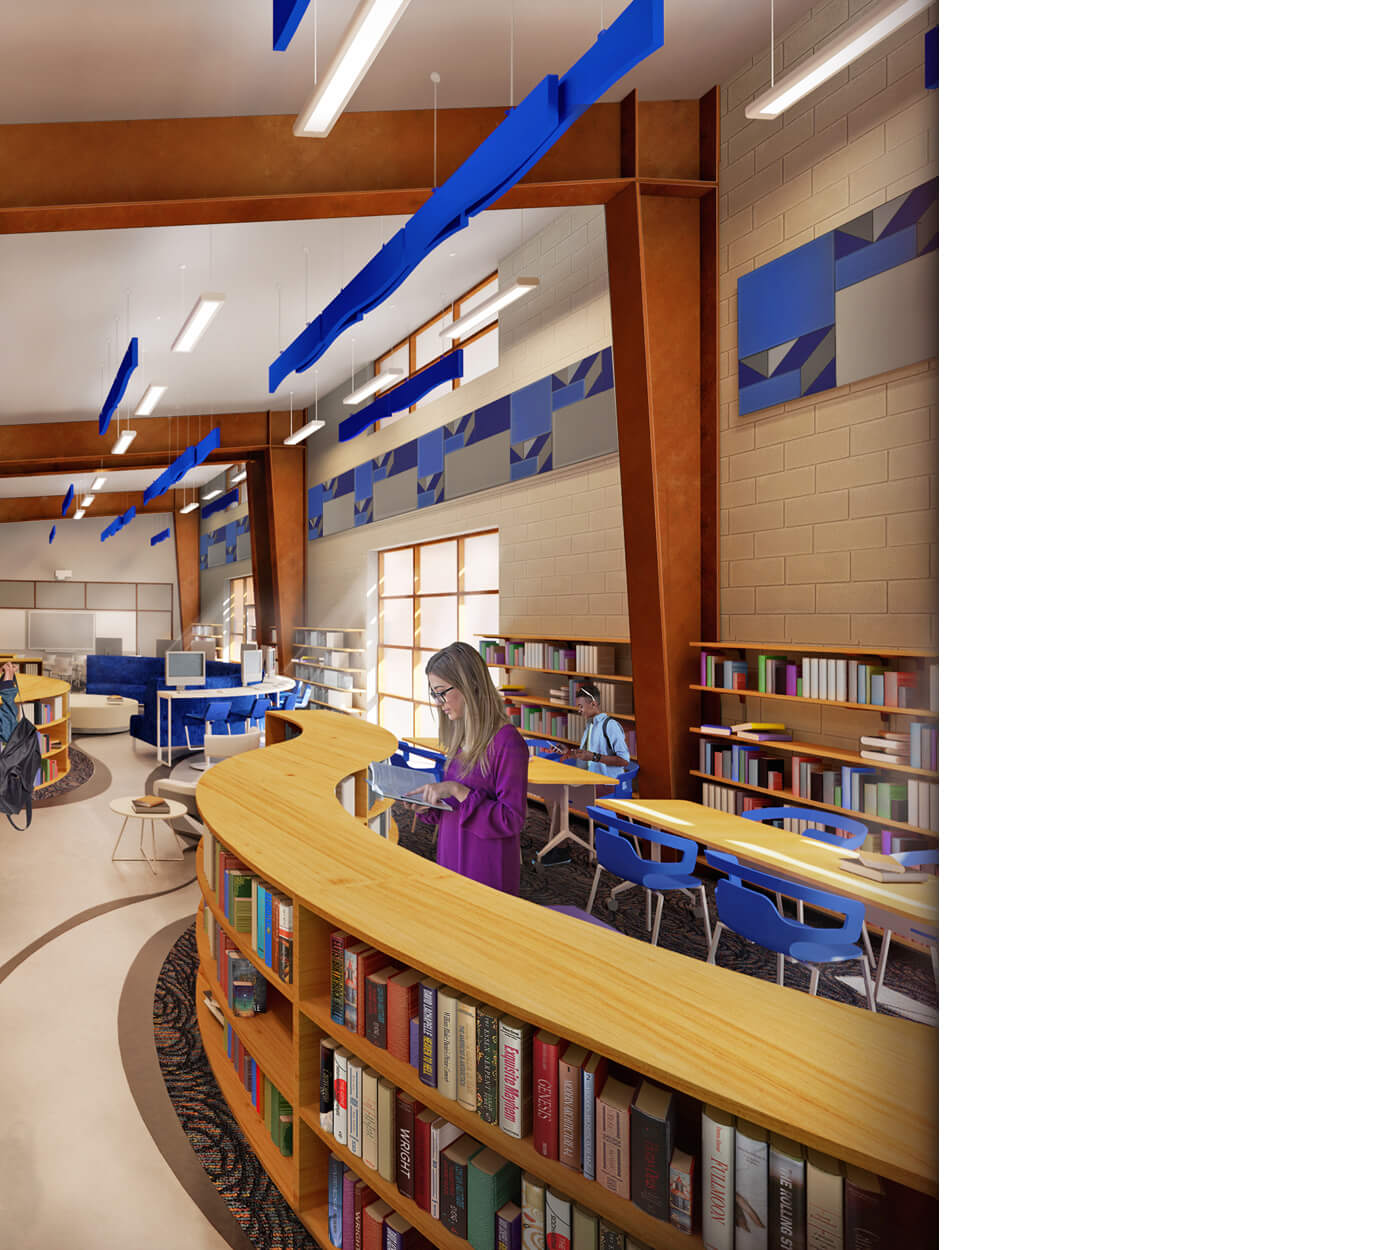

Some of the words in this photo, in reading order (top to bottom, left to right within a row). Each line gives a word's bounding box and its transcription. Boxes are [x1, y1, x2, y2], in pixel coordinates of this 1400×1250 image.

[423, 988, 432, 1004] DAVID
[423, 1004, 432, 1036] LACHAPELLE
[423, 1036, 432, 1057] HEAVEN
[501, 1045, 519, 1085] Exquisite
[423, 1063, 432, 1077] HELL
[483, 1055, 491, 1090] SERPENT
[501, 1083, 519, 1123] Mayhem
[537, 1078, 552, 1122] GENESIS
[399, 1128, 410, 1179] WRIGHT
[711, 1155, 728, 1225] FULLMOON
[779, 1188, 792, 1236] ROLLING
